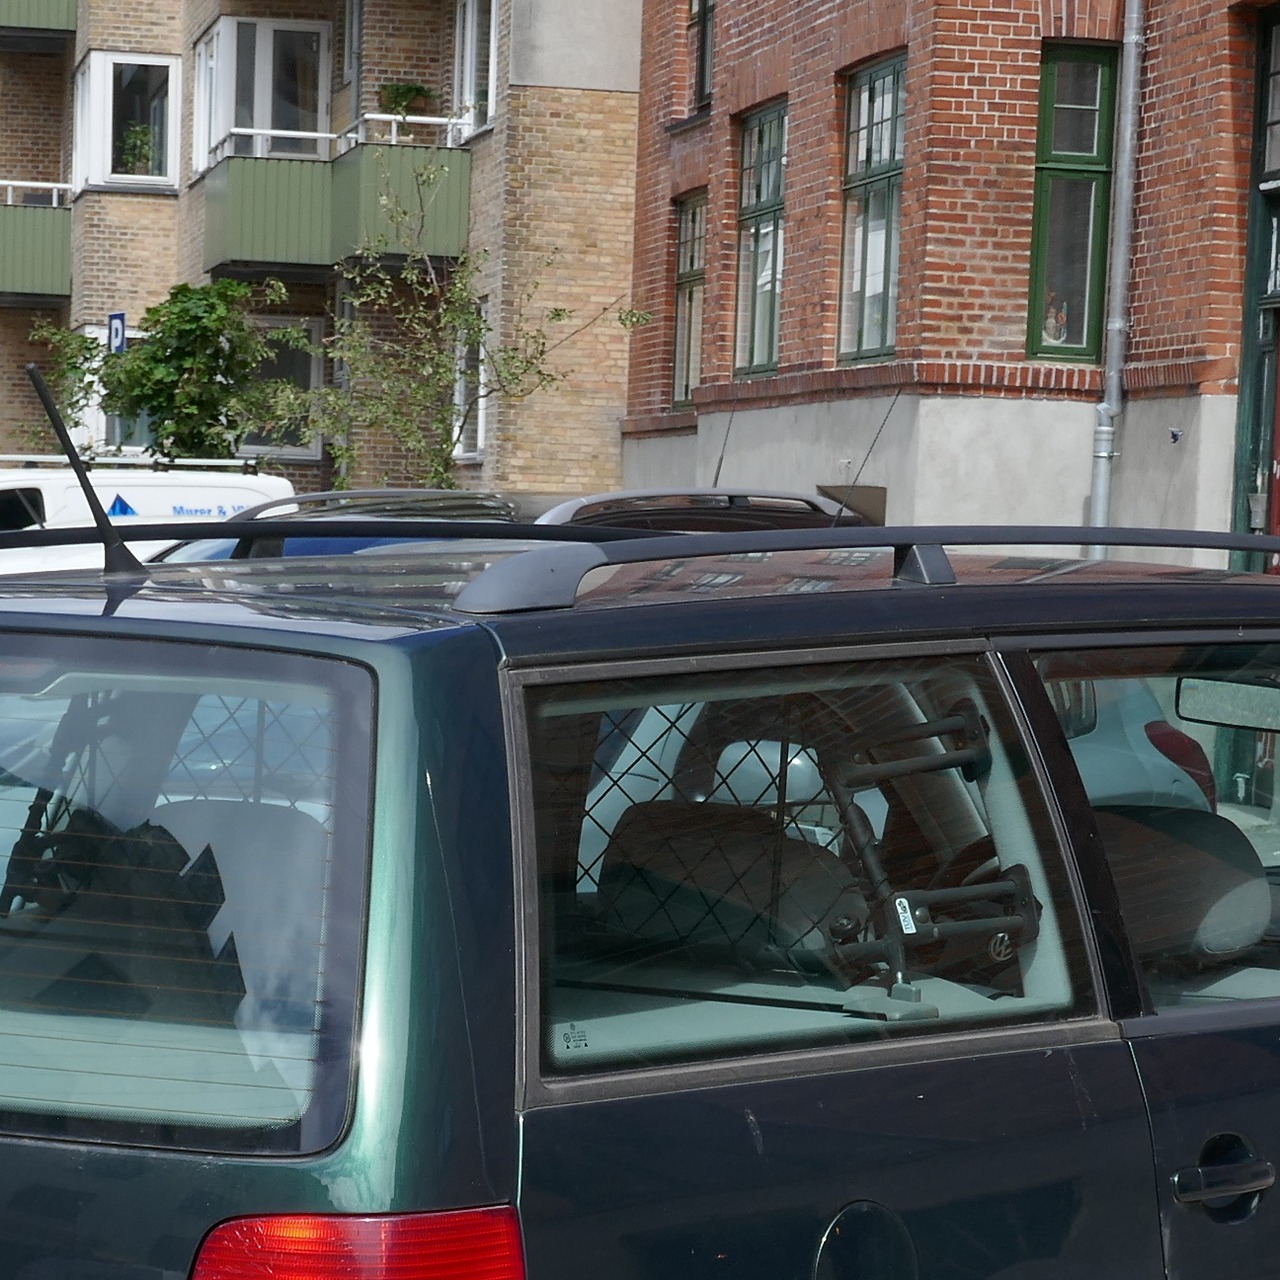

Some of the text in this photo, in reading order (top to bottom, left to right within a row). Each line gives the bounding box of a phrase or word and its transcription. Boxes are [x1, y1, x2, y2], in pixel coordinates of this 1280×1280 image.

[111, 319, 122, 353] P
[173, 506, 211, 515] Murer
[217, 505, 226, 515] &
